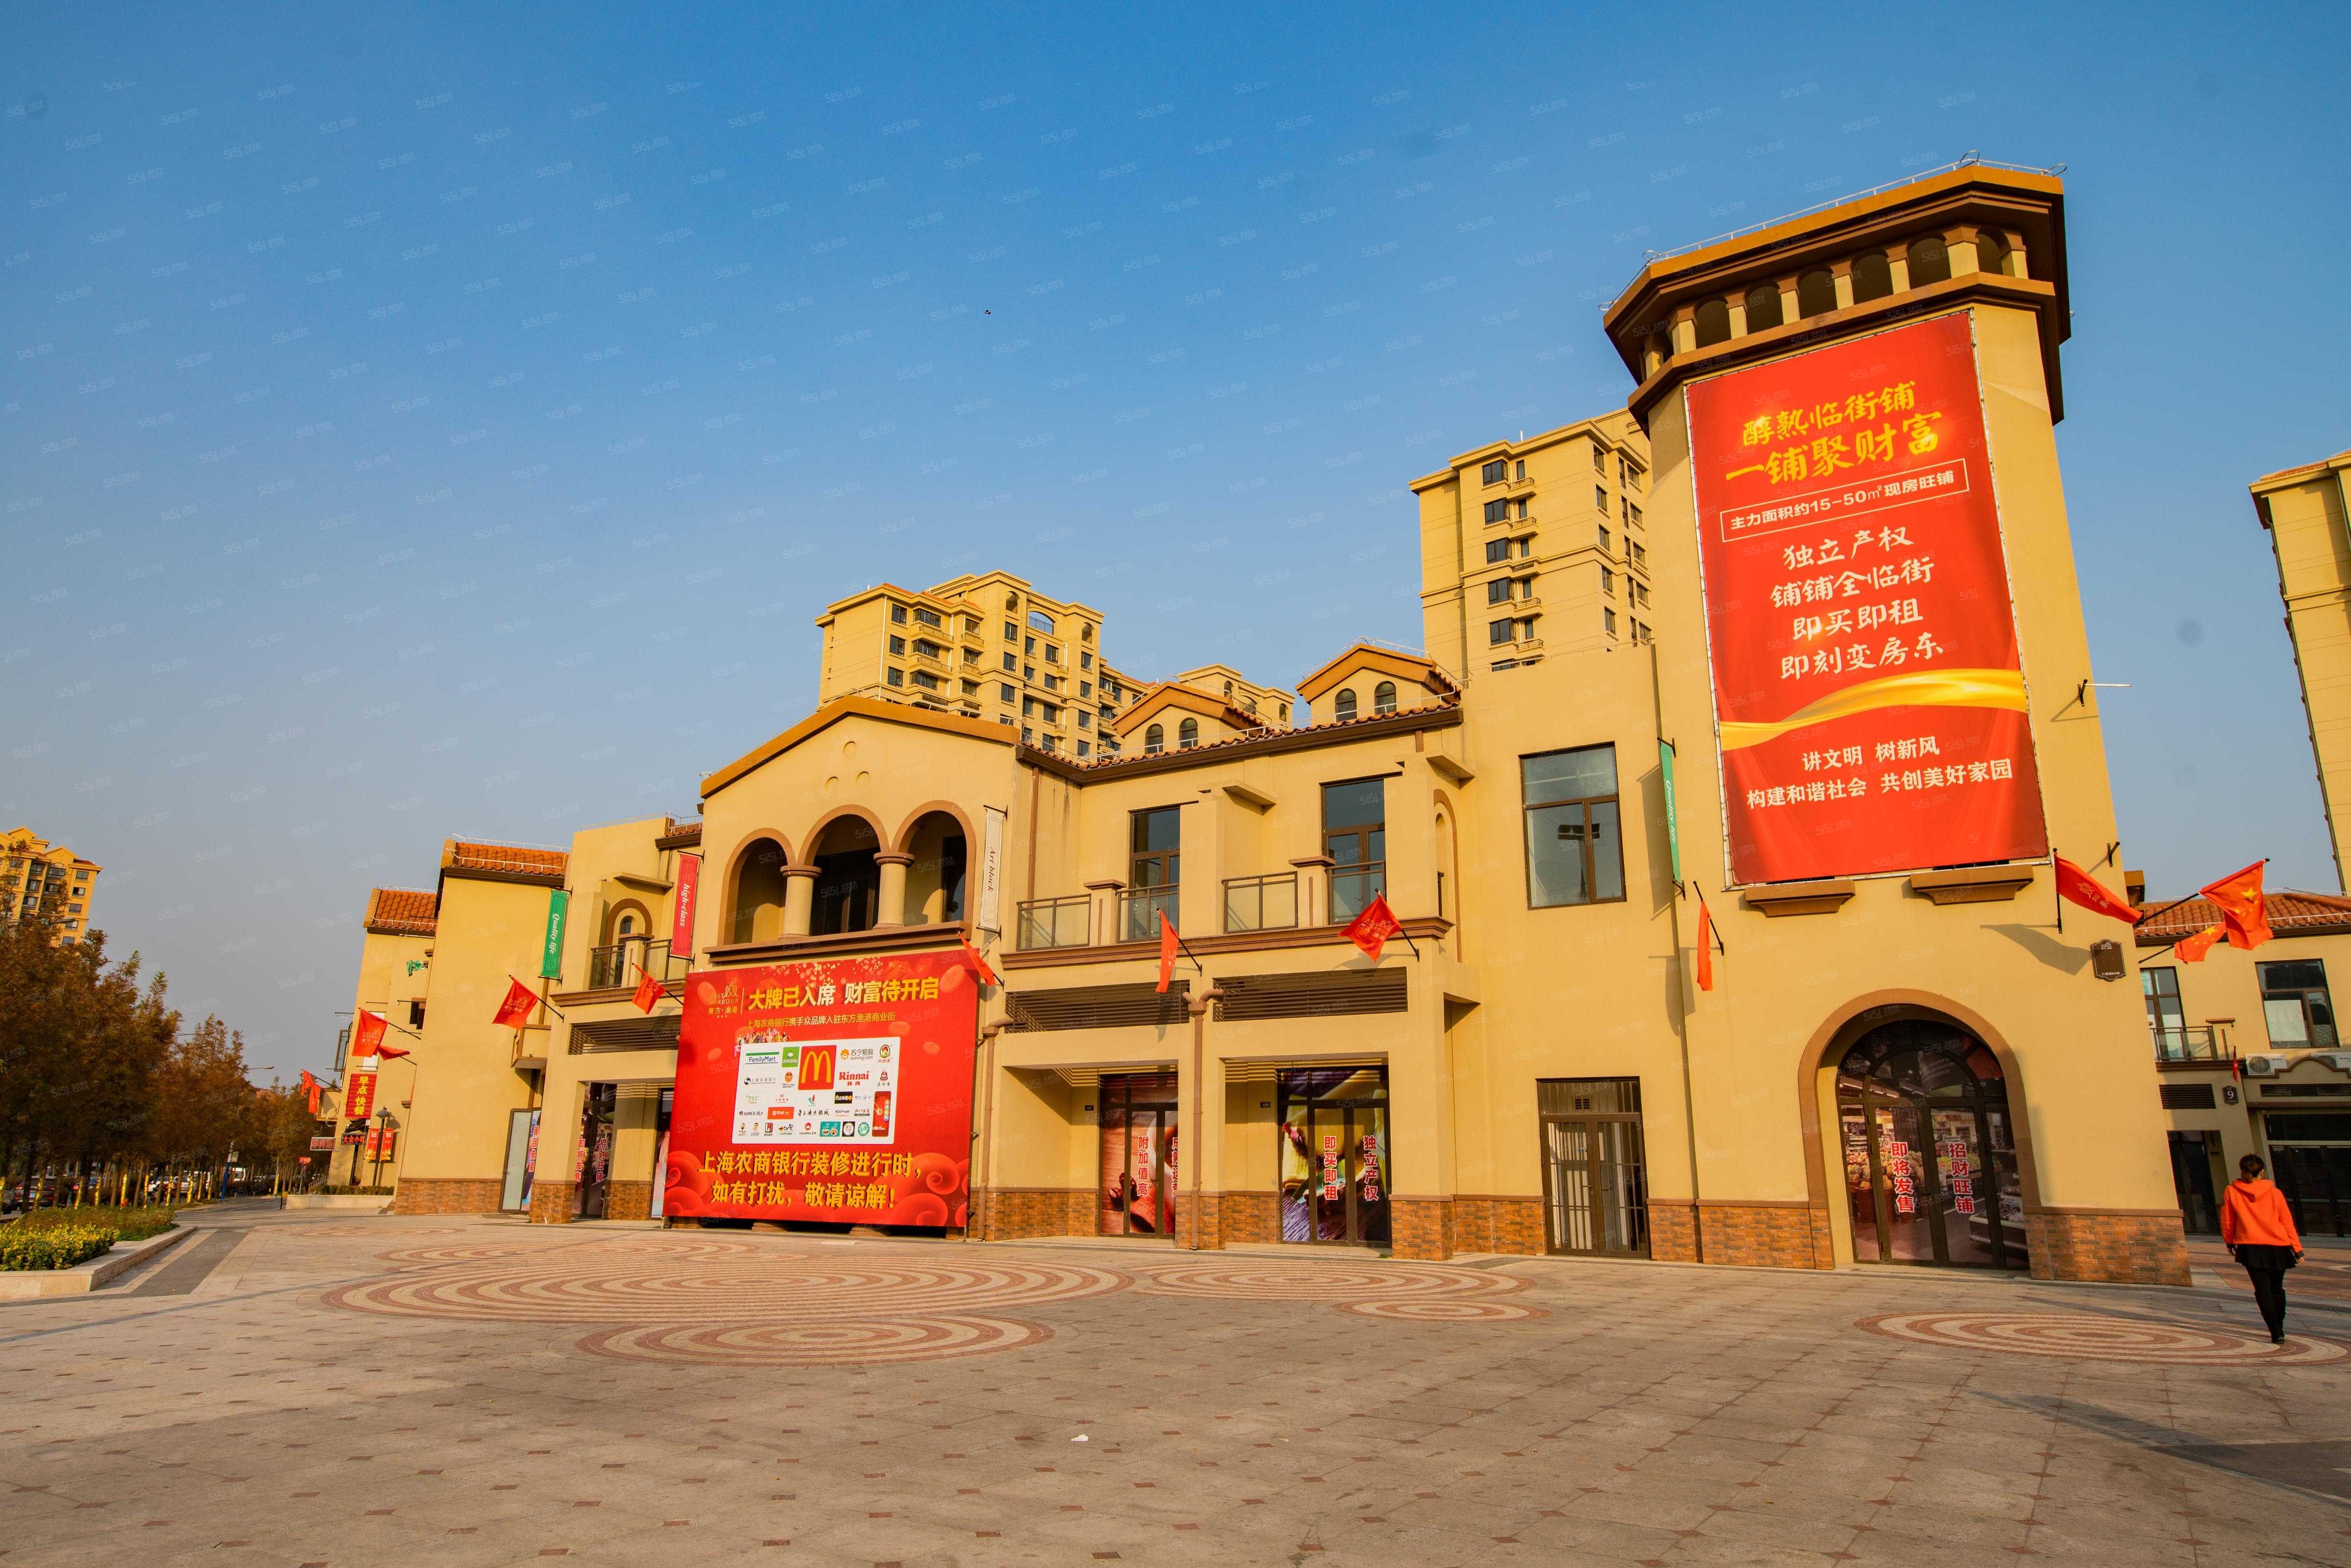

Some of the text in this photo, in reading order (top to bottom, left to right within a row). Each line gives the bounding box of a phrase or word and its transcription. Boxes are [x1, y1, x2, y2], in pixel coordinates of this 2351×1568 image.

[1725, 411, 1943, 485] 一铺聚财富
[1782, 525, 1914, 572] 独立产权
[1770, 556, 1935, 609] 铺铺全临街
[1792, 597, 1923, 642] 即买即租
[1780, 631, 1944, 681] 即刻变房东
[1802, 736, 1940, 772] 讲文明 树新风
[1747, 758, 2013, 810] 构建和谐社会 共创美好家园
[550, 913, 560, 942] Quality
[679, 883, 690, 927] high-class
[748, 976, 939, 1011] 大牌已入席 财富待开启
[354, 1076, 369, 1116] 早点快餐
[839, 1070, 869, 1080] Rinnai
[2227, 1091, 2233, 1099] 9
[575, 1139, 585, 1182] 即将发售
[596, 1139, 607, 1182] 招财旺铺
[1137, 1136, 1149, 1196] 附加值高
[1324, 1136, 1338, 1200] 即买即租
[1364, 1135, 1379, 1201] 独立产权
[1891, 1141, 1915, 1213] 即将发售
[1948, 1142, 1974, 1213] 招财旺铺
